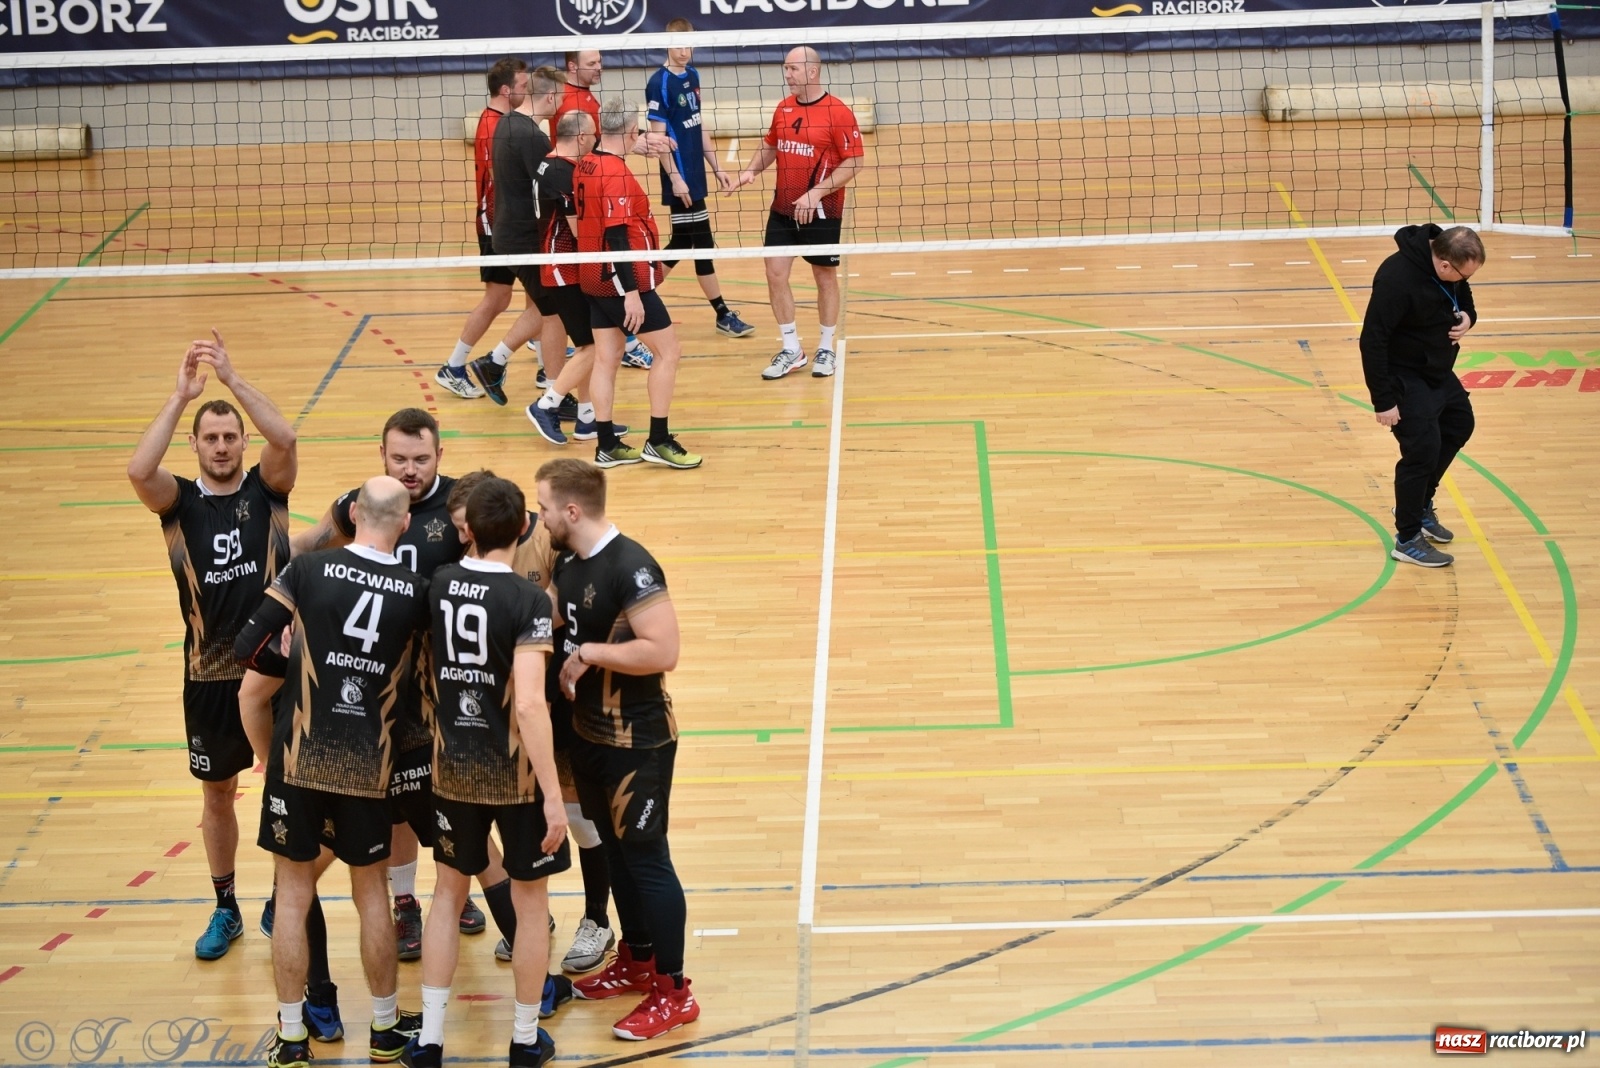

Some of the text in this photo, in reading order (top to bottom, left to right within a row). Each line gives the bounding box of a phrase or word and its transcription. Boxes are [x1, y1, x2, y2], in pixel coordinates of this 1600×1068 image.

[0, 0, 167, 36] IBORZ
[347, 22, 439, 42] RACIBÓRZ
[791, 116, 803, 135] 4
[213, 527, 243, 565] 99
[204, 560, 258, 584] AGROTIM
[323, 562, 414, 598] KOCZWARA
[448, 579, 490, 600] BART
[342, 590, 384, 654] 4
[566, 601, 578, 636] 5
[440, 598, 488, 666] 19
[325, 651, 386, 676] AGROTIM
[440, 666, 496, 686] AGROTIM
[190, 751, 211, 772] 99
[390, 781, 421, 797] TEAM
